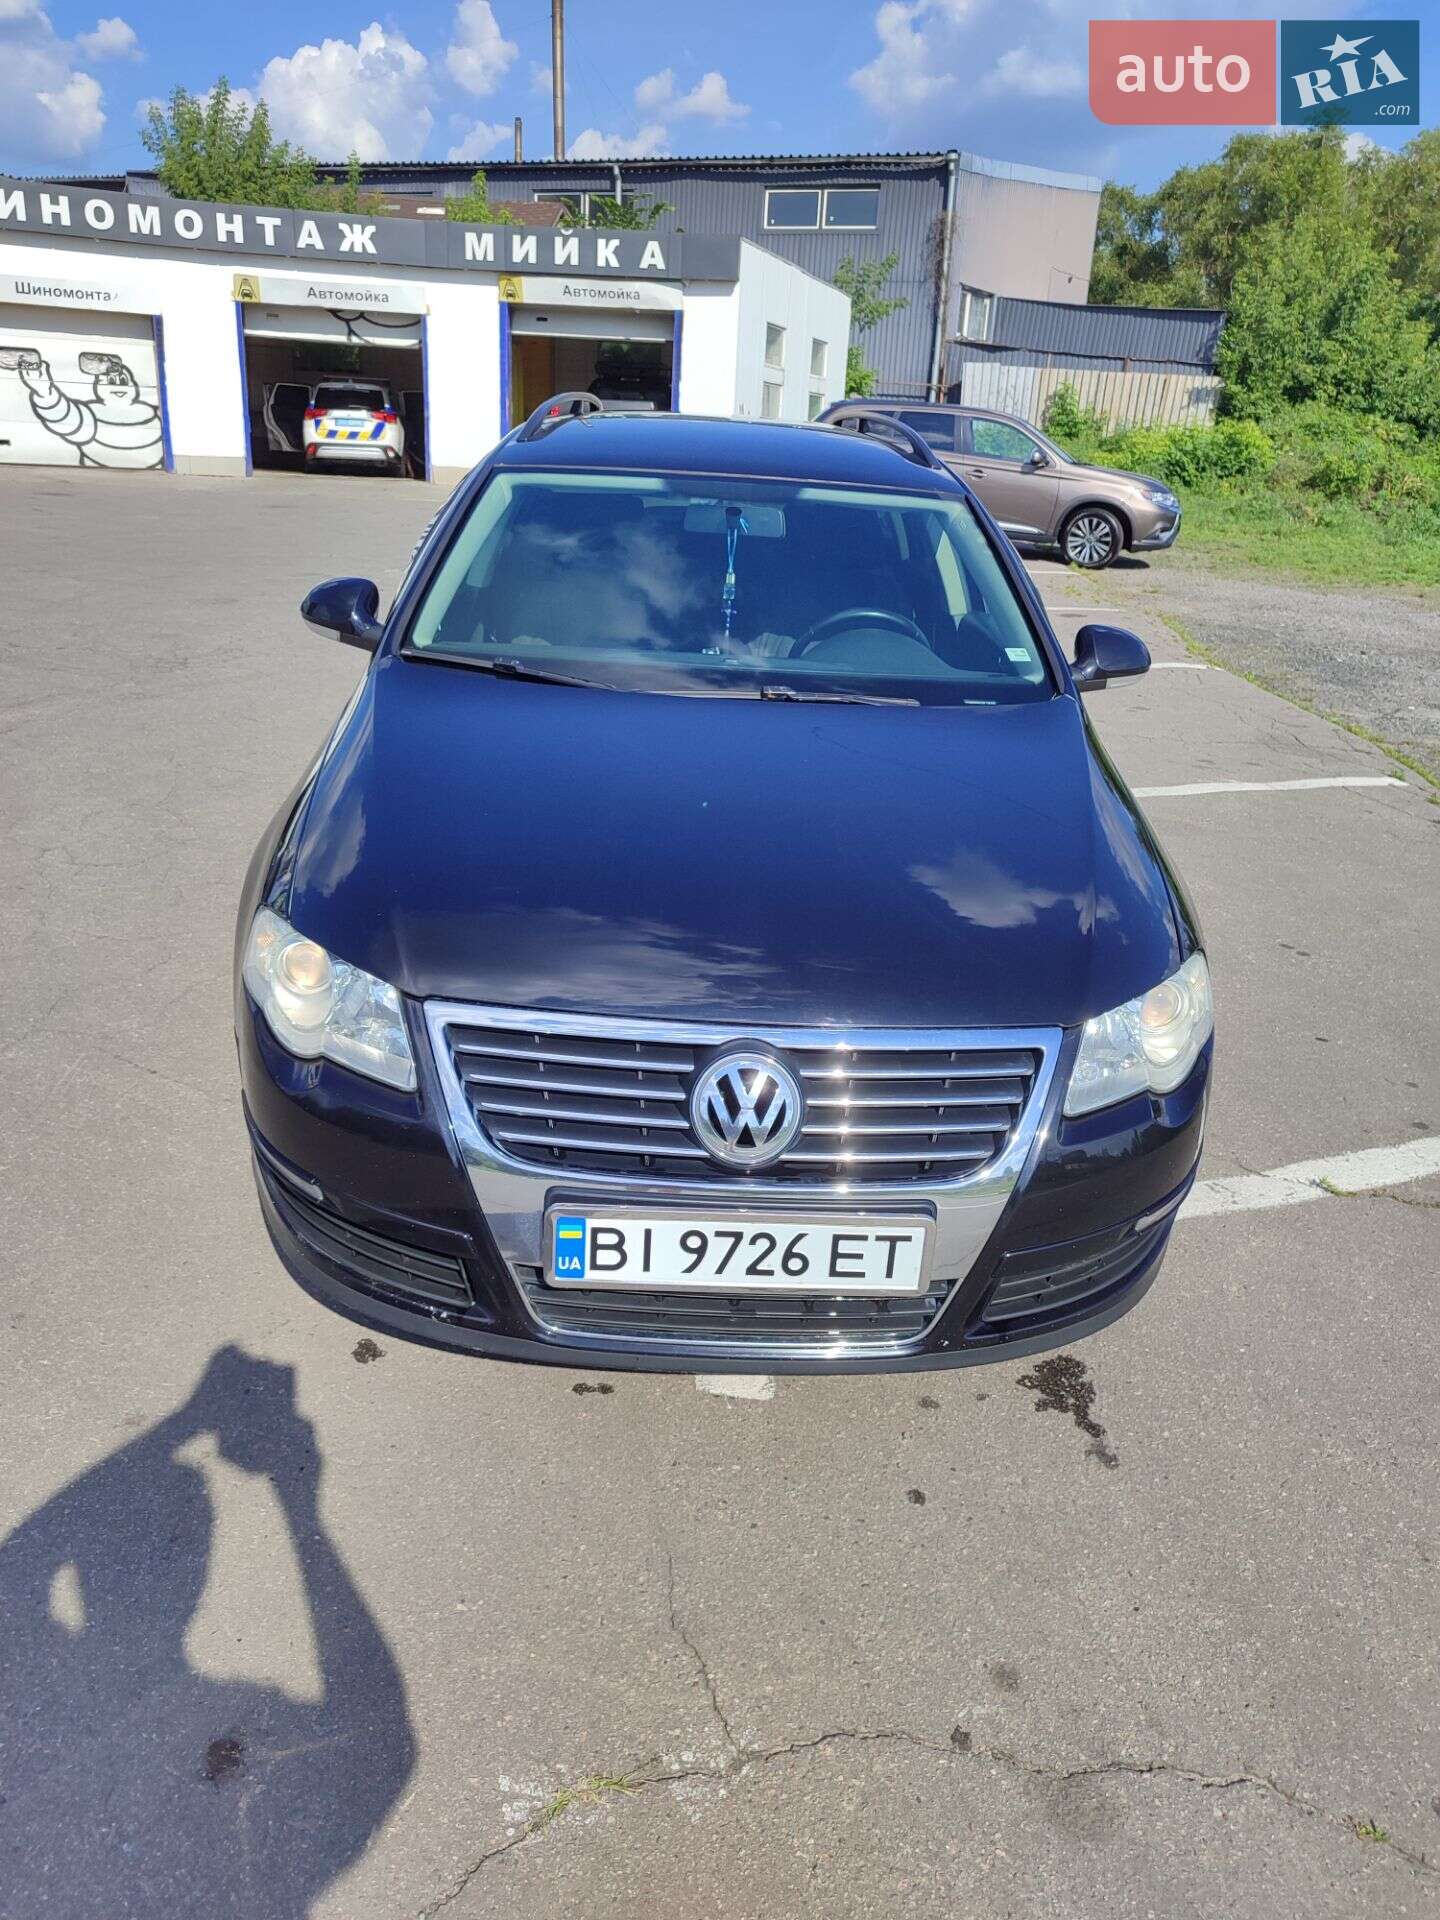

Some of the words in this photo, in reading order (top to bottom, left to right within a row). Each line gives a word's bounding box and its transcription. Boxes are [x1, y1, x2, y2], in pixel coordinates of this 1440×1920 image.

[0, 188, 377, 254] ИНОМОНТАЖ
[464, 228, 667, 270] МИЙКА
[15, 281, 118, 301] Шиномонта
[307, 286, 389, 303] Автомойка
[562, 284, 641, 301] Автомойка
[589, 1227, 652, 1273] BI
[679, 1230, 811, 1277] 9726
[829, 1233, 913, 1279] ET
[558, 1256, 582, 1271] UA
